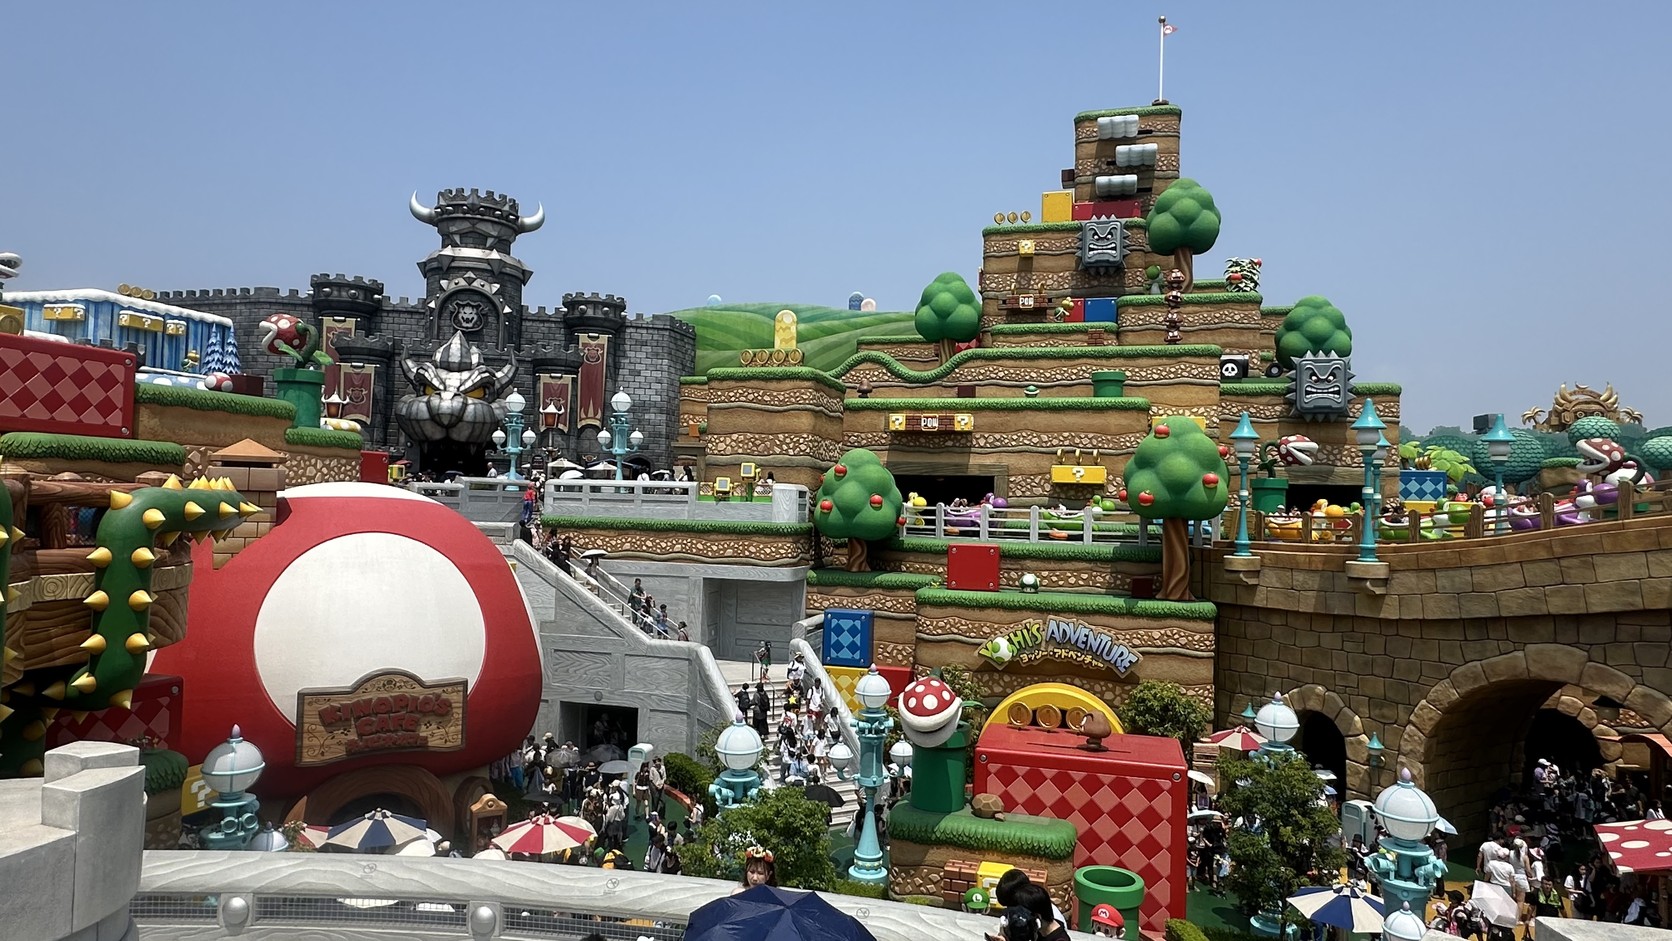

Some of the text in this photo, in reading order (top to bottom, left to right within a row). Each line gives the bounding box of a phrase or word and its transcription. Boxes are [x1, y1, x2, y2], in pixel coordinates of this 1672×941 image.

[921, 417, 939, 428] POW
[1046, 618, 1138, 672] ADVENTURE
[317, 692, 453, 725] KINOPIO'S
[355, 712, 421, 736] CAFE
